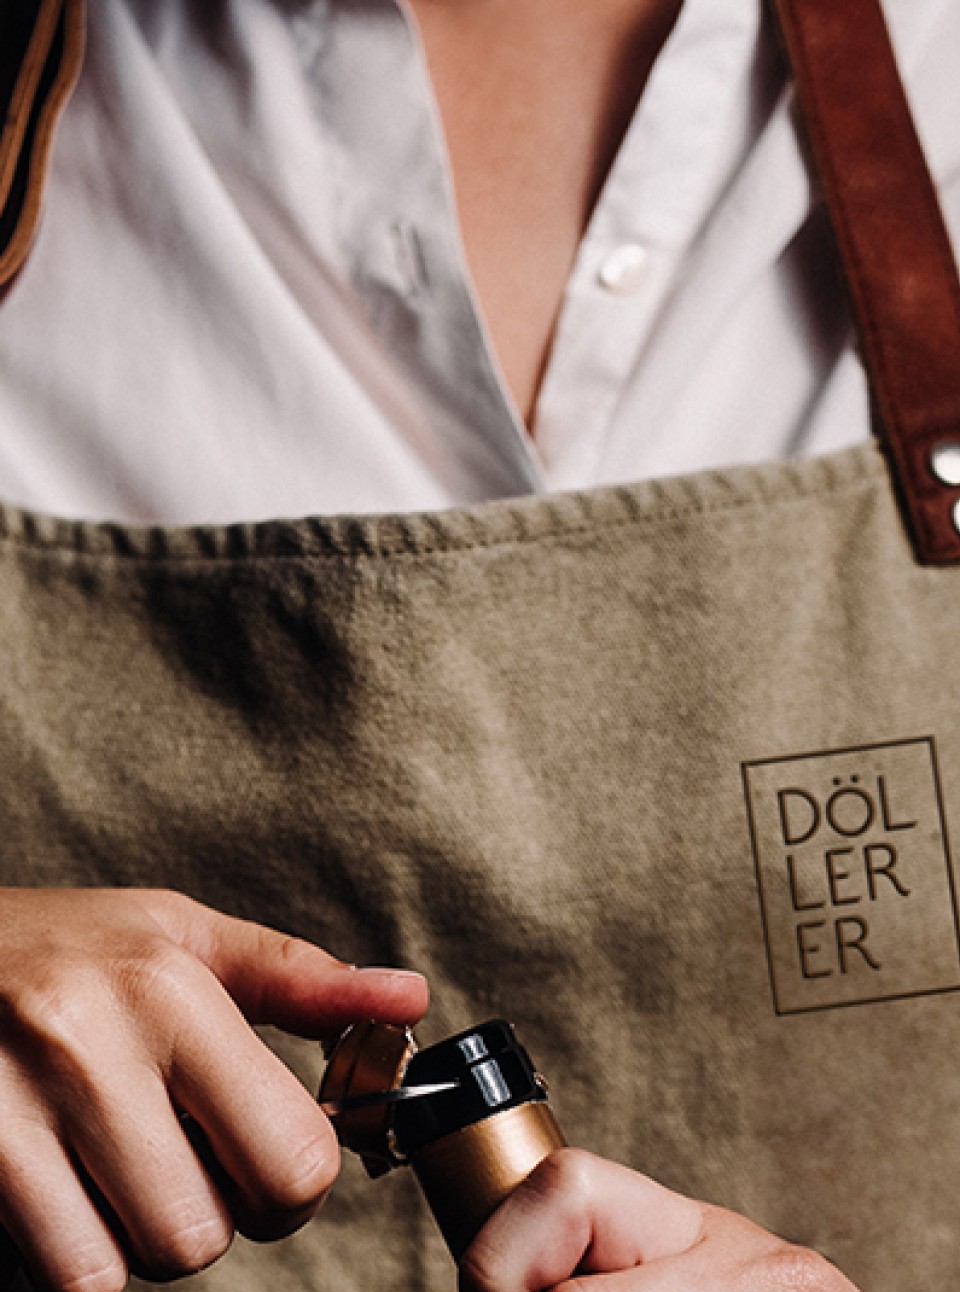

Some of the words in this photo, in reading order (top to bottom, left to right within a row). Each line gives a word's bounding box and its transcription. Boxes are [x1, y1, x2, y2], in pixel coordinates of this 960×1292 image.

[777, 774, 918, 846] DÖL
[786, 843, 911, 911] LER
[796, 915, 881, 979] ER
